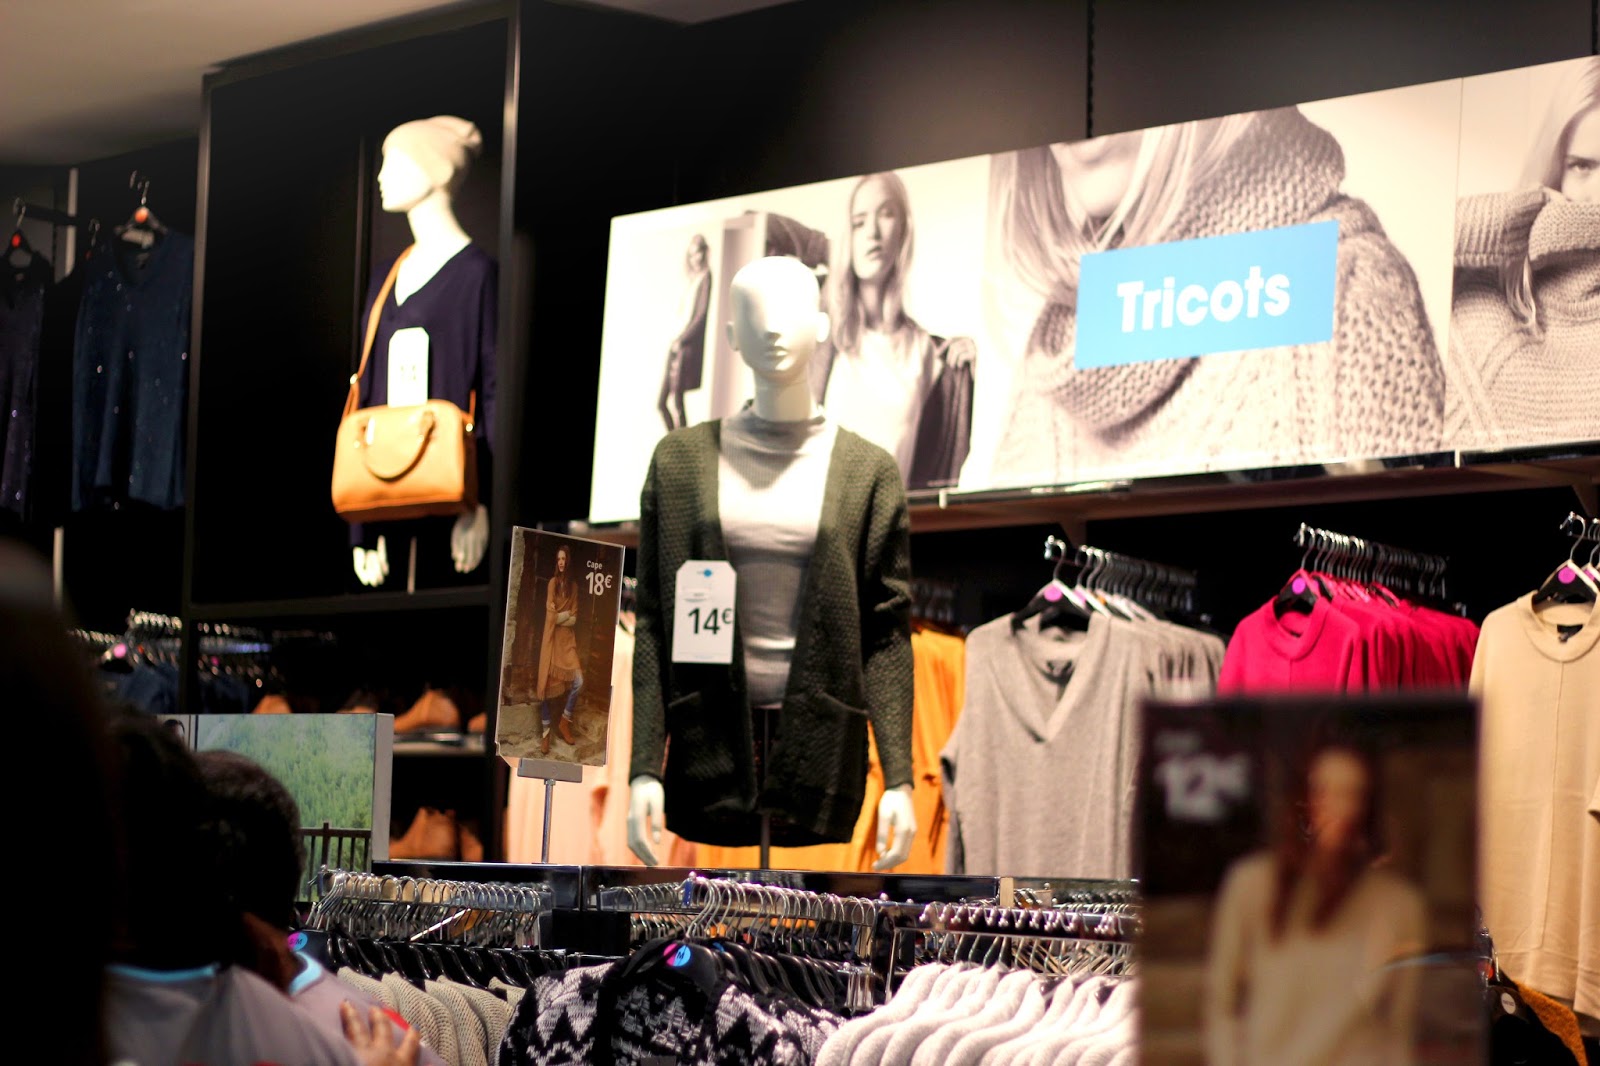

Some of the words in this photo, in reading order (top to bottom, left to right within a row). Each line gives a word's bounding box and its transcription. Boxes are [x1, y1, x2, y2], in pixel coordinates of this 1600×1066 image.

[1117, 266, 1290, 333] Tricots
[586, 560, 603, 572] Cape
[585, 571, 613, 596] 18€
[688, 607, 733, 635] 14€
